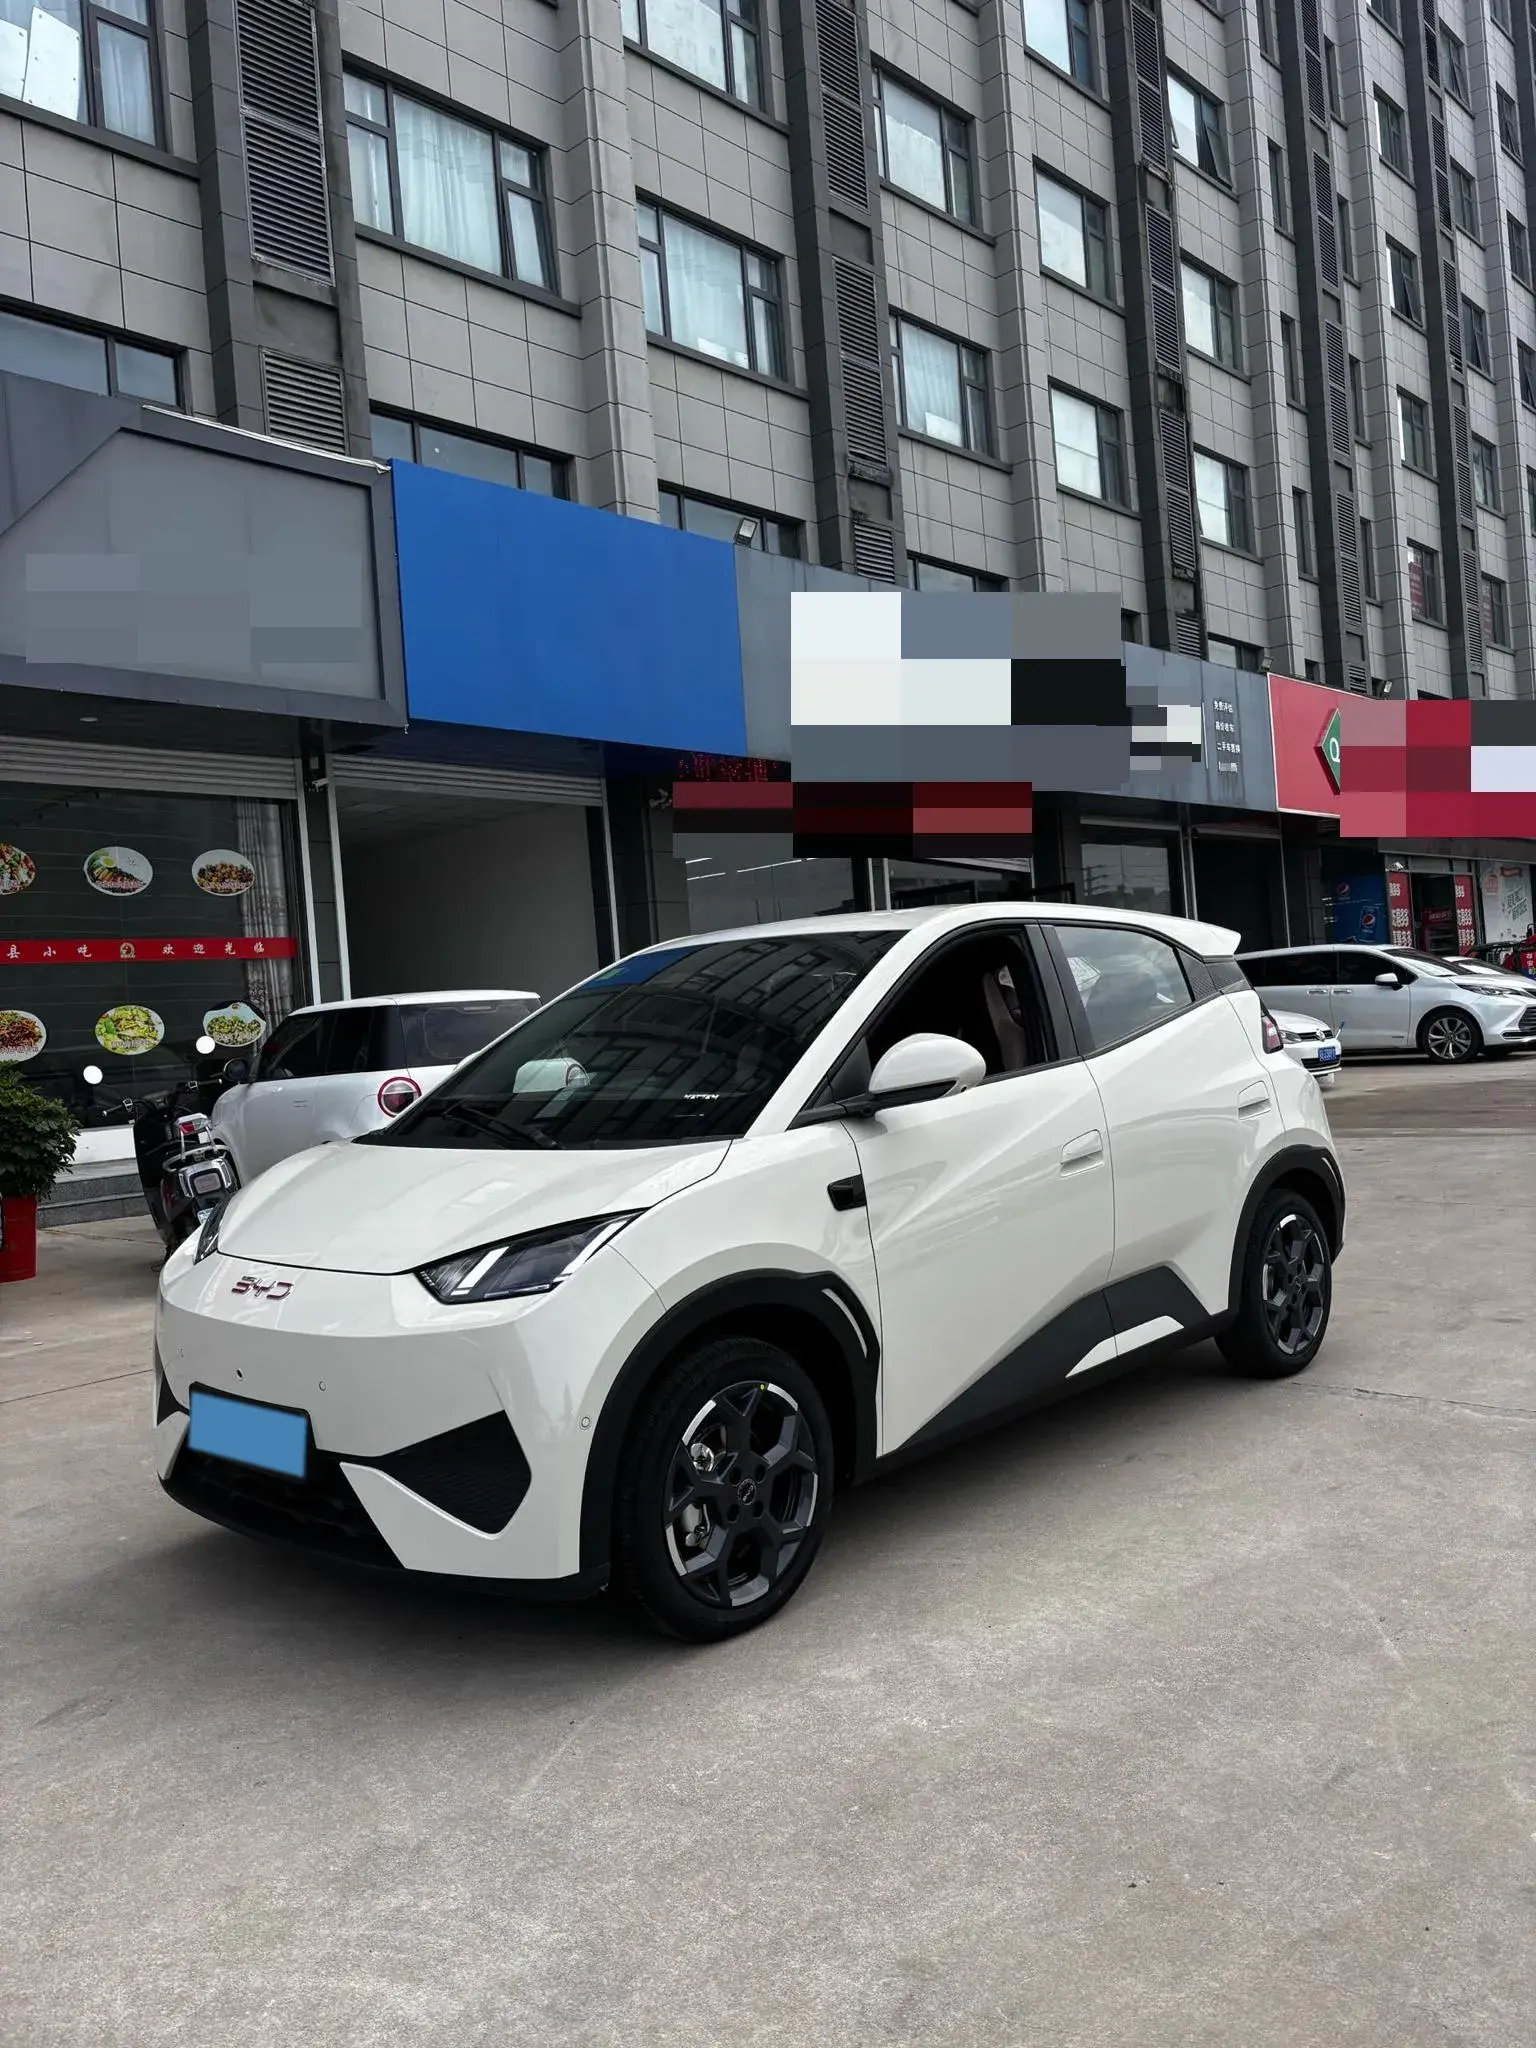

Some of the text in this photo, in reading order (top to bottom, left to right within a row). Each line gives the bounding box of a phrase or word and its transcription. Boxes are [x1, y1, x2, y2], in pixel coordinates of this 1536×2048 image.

[1217, 742, 1241, 754] 二手车置换
[162, 941, 265, 955] 欢迎光临
[231, 1275, 294, 1300] BYD
